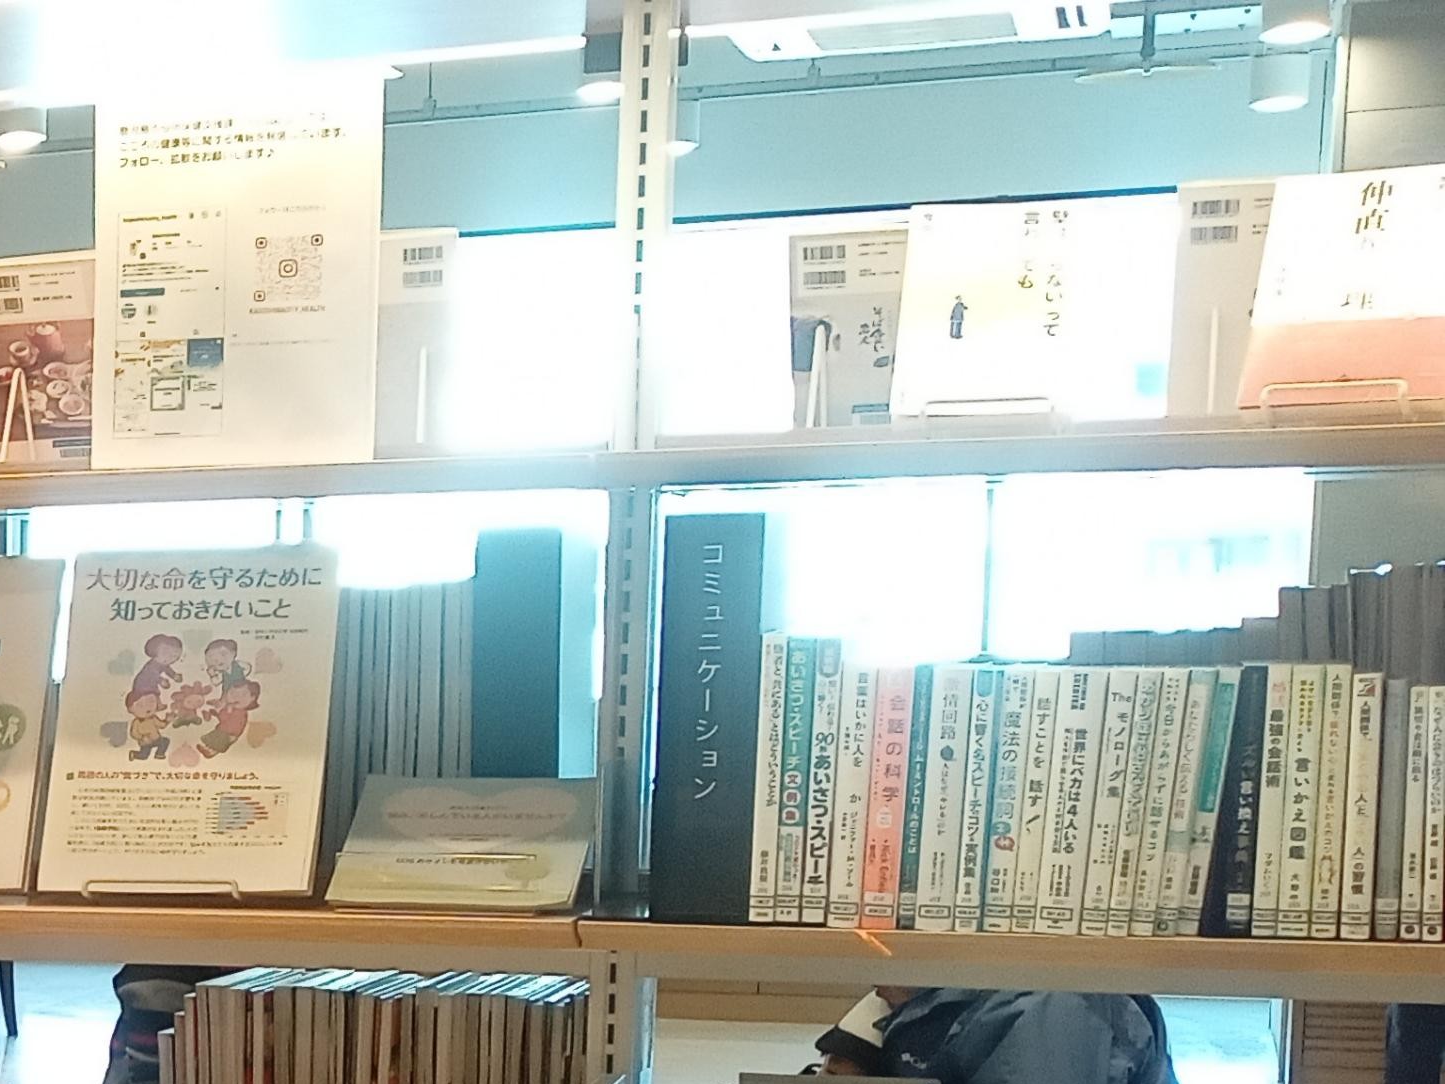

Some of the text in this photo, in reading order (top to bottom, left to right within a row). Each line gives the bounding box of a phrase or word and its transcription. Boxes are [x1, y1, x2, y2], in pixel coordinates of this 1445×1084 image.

[85, 566, 323, 592] 大切な命を守るために
[109, 598, 292, 623] 知っておきたいこと
[693, 543, 725, 801] コミュニケーション
[1061, 728, 1088, 854] 世界にバカは4人いる
[1288, 756, 1312, 861] 言いかえ図鑑
